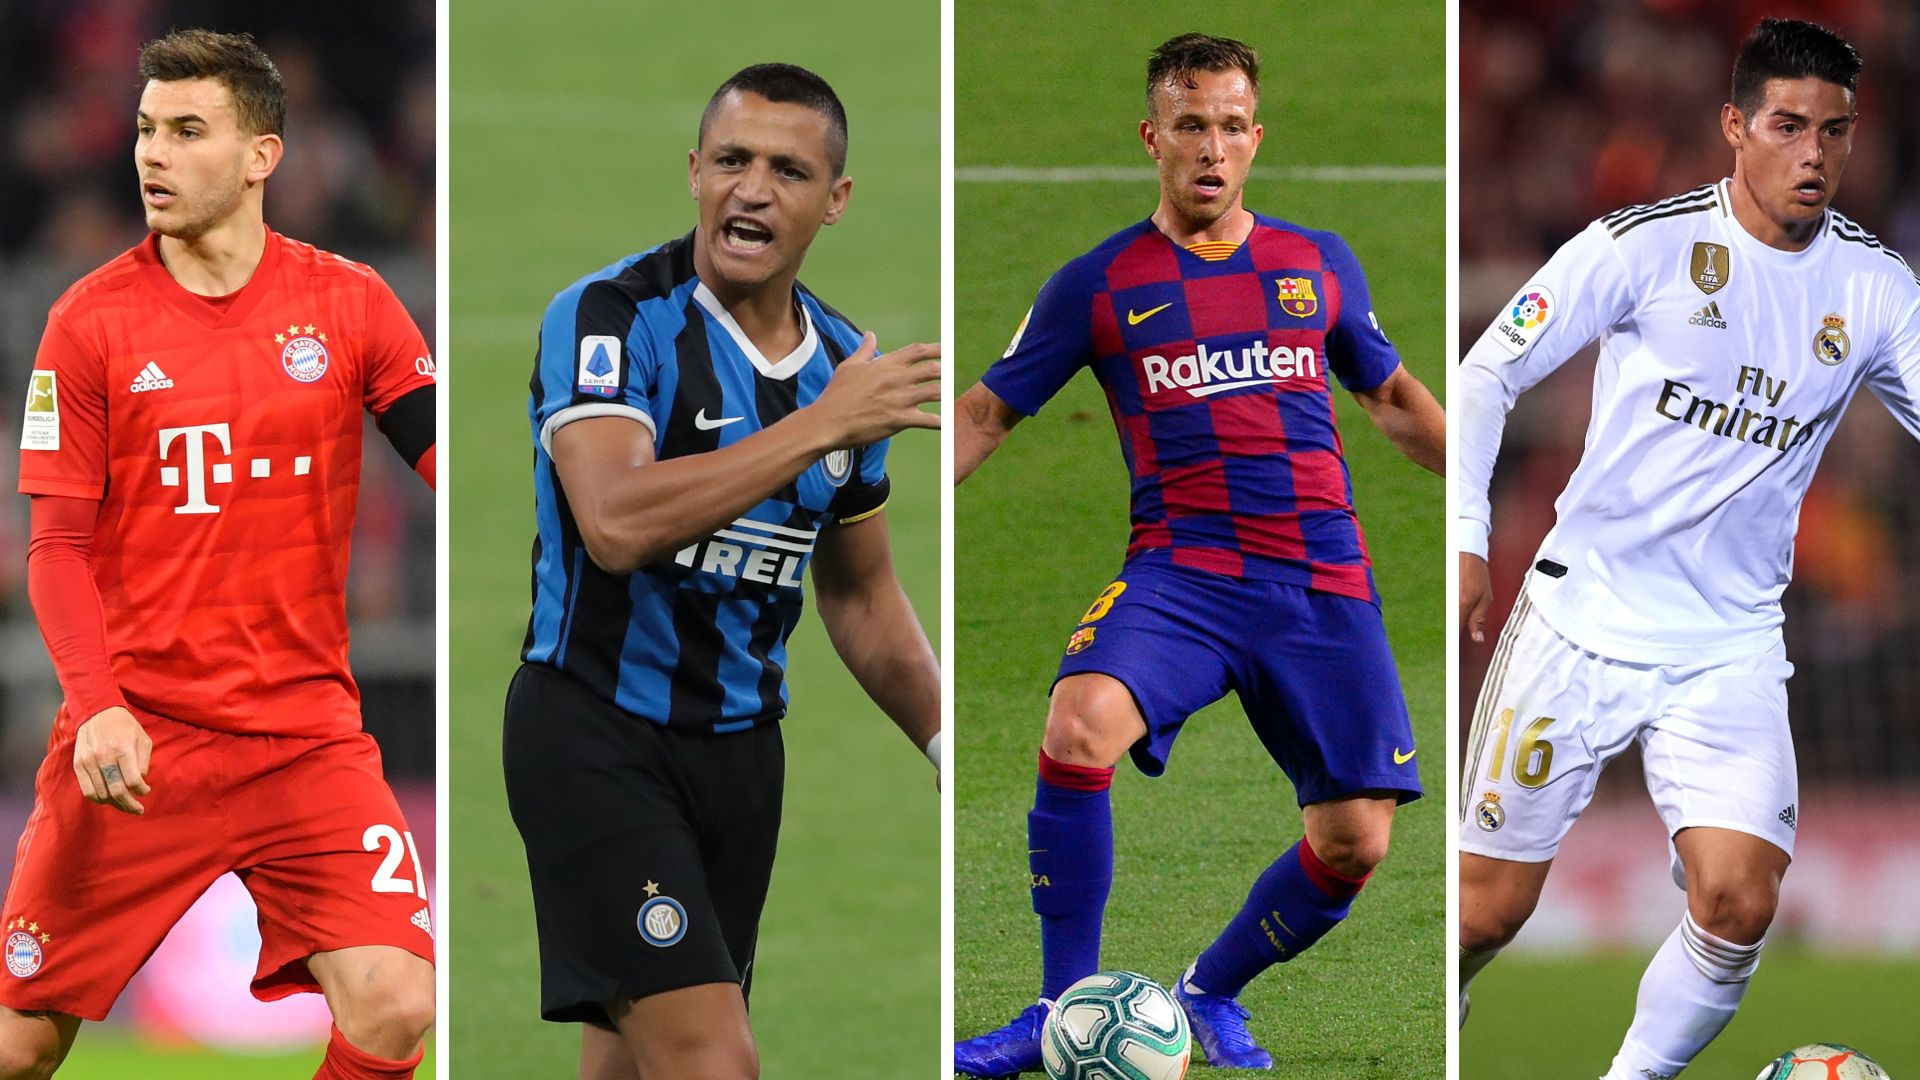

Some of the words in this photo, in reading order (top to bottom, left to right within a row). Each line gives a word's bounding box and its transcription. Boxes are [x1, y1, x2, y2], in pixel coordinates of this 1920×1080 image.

[1700, 274, 1719, 283] FIFA
[1498, 321, 1527, 346] LaLiga
[1688, 315, 1727, 329] adidas
[285, 345, 295, 358] FC
[293, 340, 325, 357] BAYERN
[1142, 341, 1317, 394] Rakuten
[130, 378, 174, 393] adidas
[1736, 365, 1787, 407] Fly
[1079, 581, 1128, 626] 8
[1487, 707, 1557, 789] 16
[362, 823, 428, 901] 21
[16, 934, 40, 956] BAYERN
